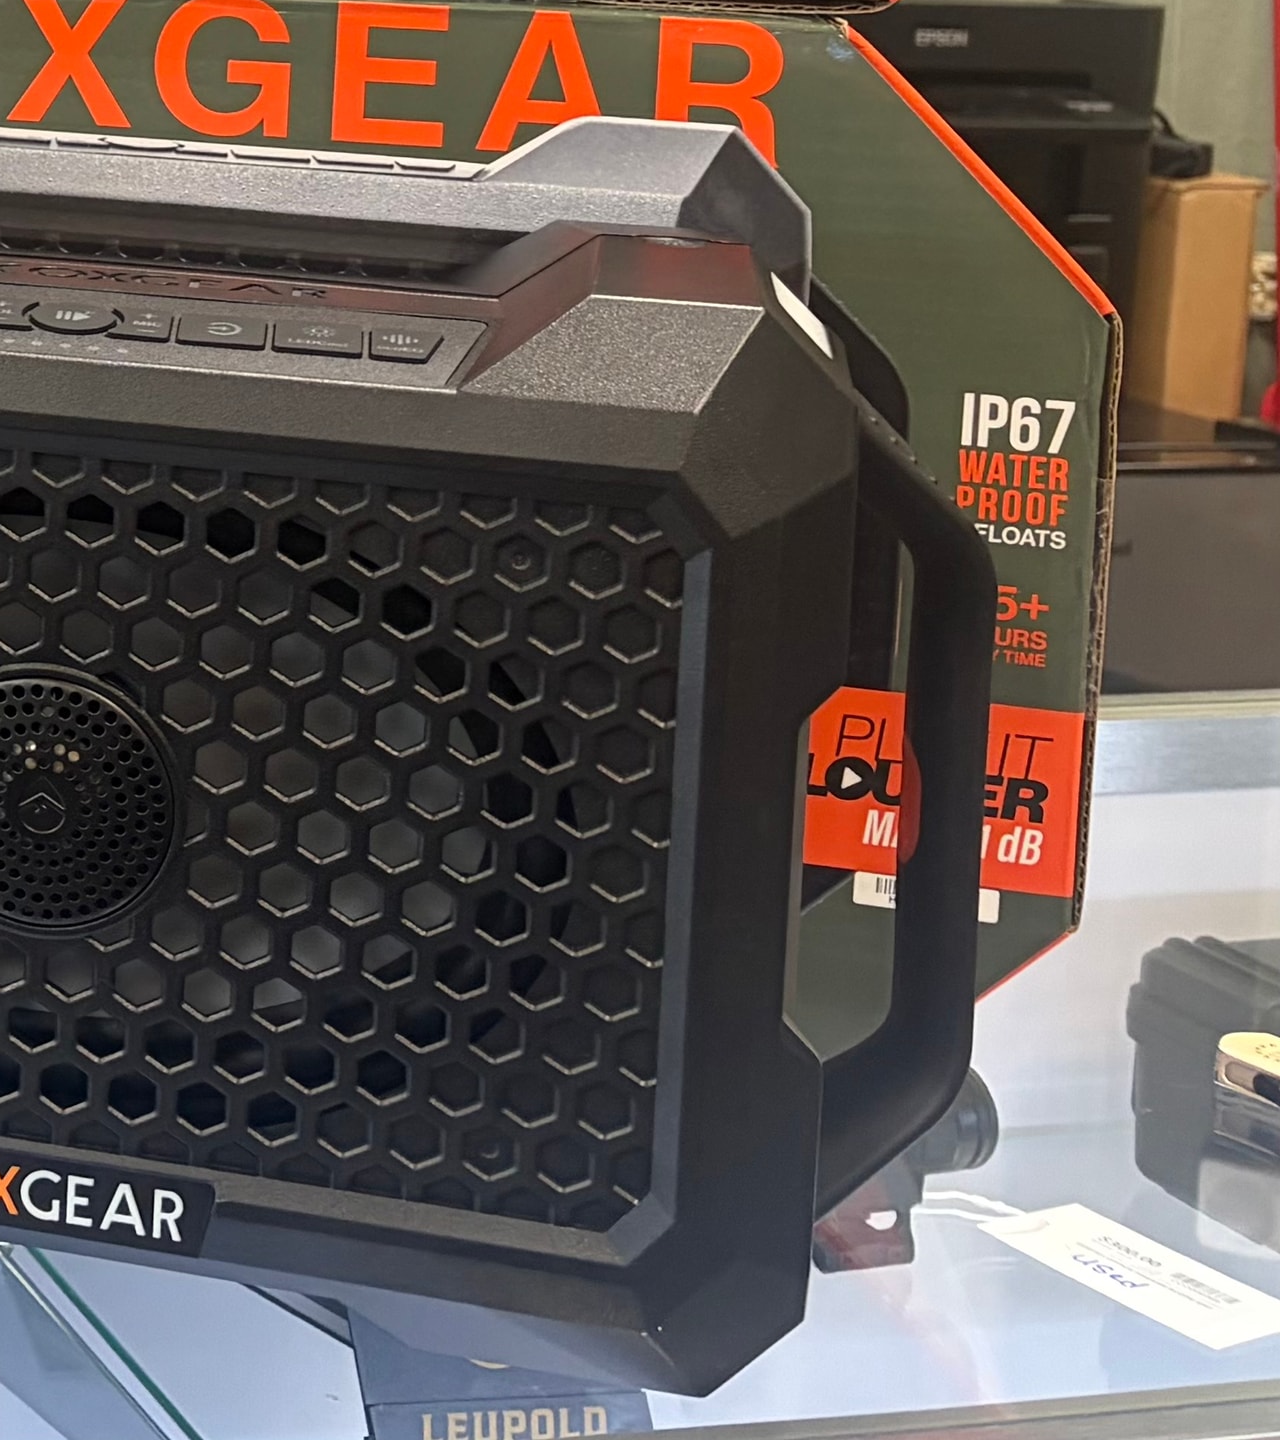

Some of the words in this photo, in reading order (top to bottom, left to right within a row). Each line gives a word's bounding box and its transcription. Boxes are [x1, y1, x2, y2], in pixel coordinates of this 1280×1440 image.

[960, 392, 1077, 455] IP67
[957, 449, 1069, 492] WATER
[955, 485, 1068, 527] PROOF
[995, 584, 1050, 622] 5+
[994, 630, 1048, 651] URS
[1003, 650, 1046, 668] TIME
[1000, 733, 1054, 780] IT
[997, 826, 1044, 866] dB
[422, 1406, 608, 1440] LEUPOLD
